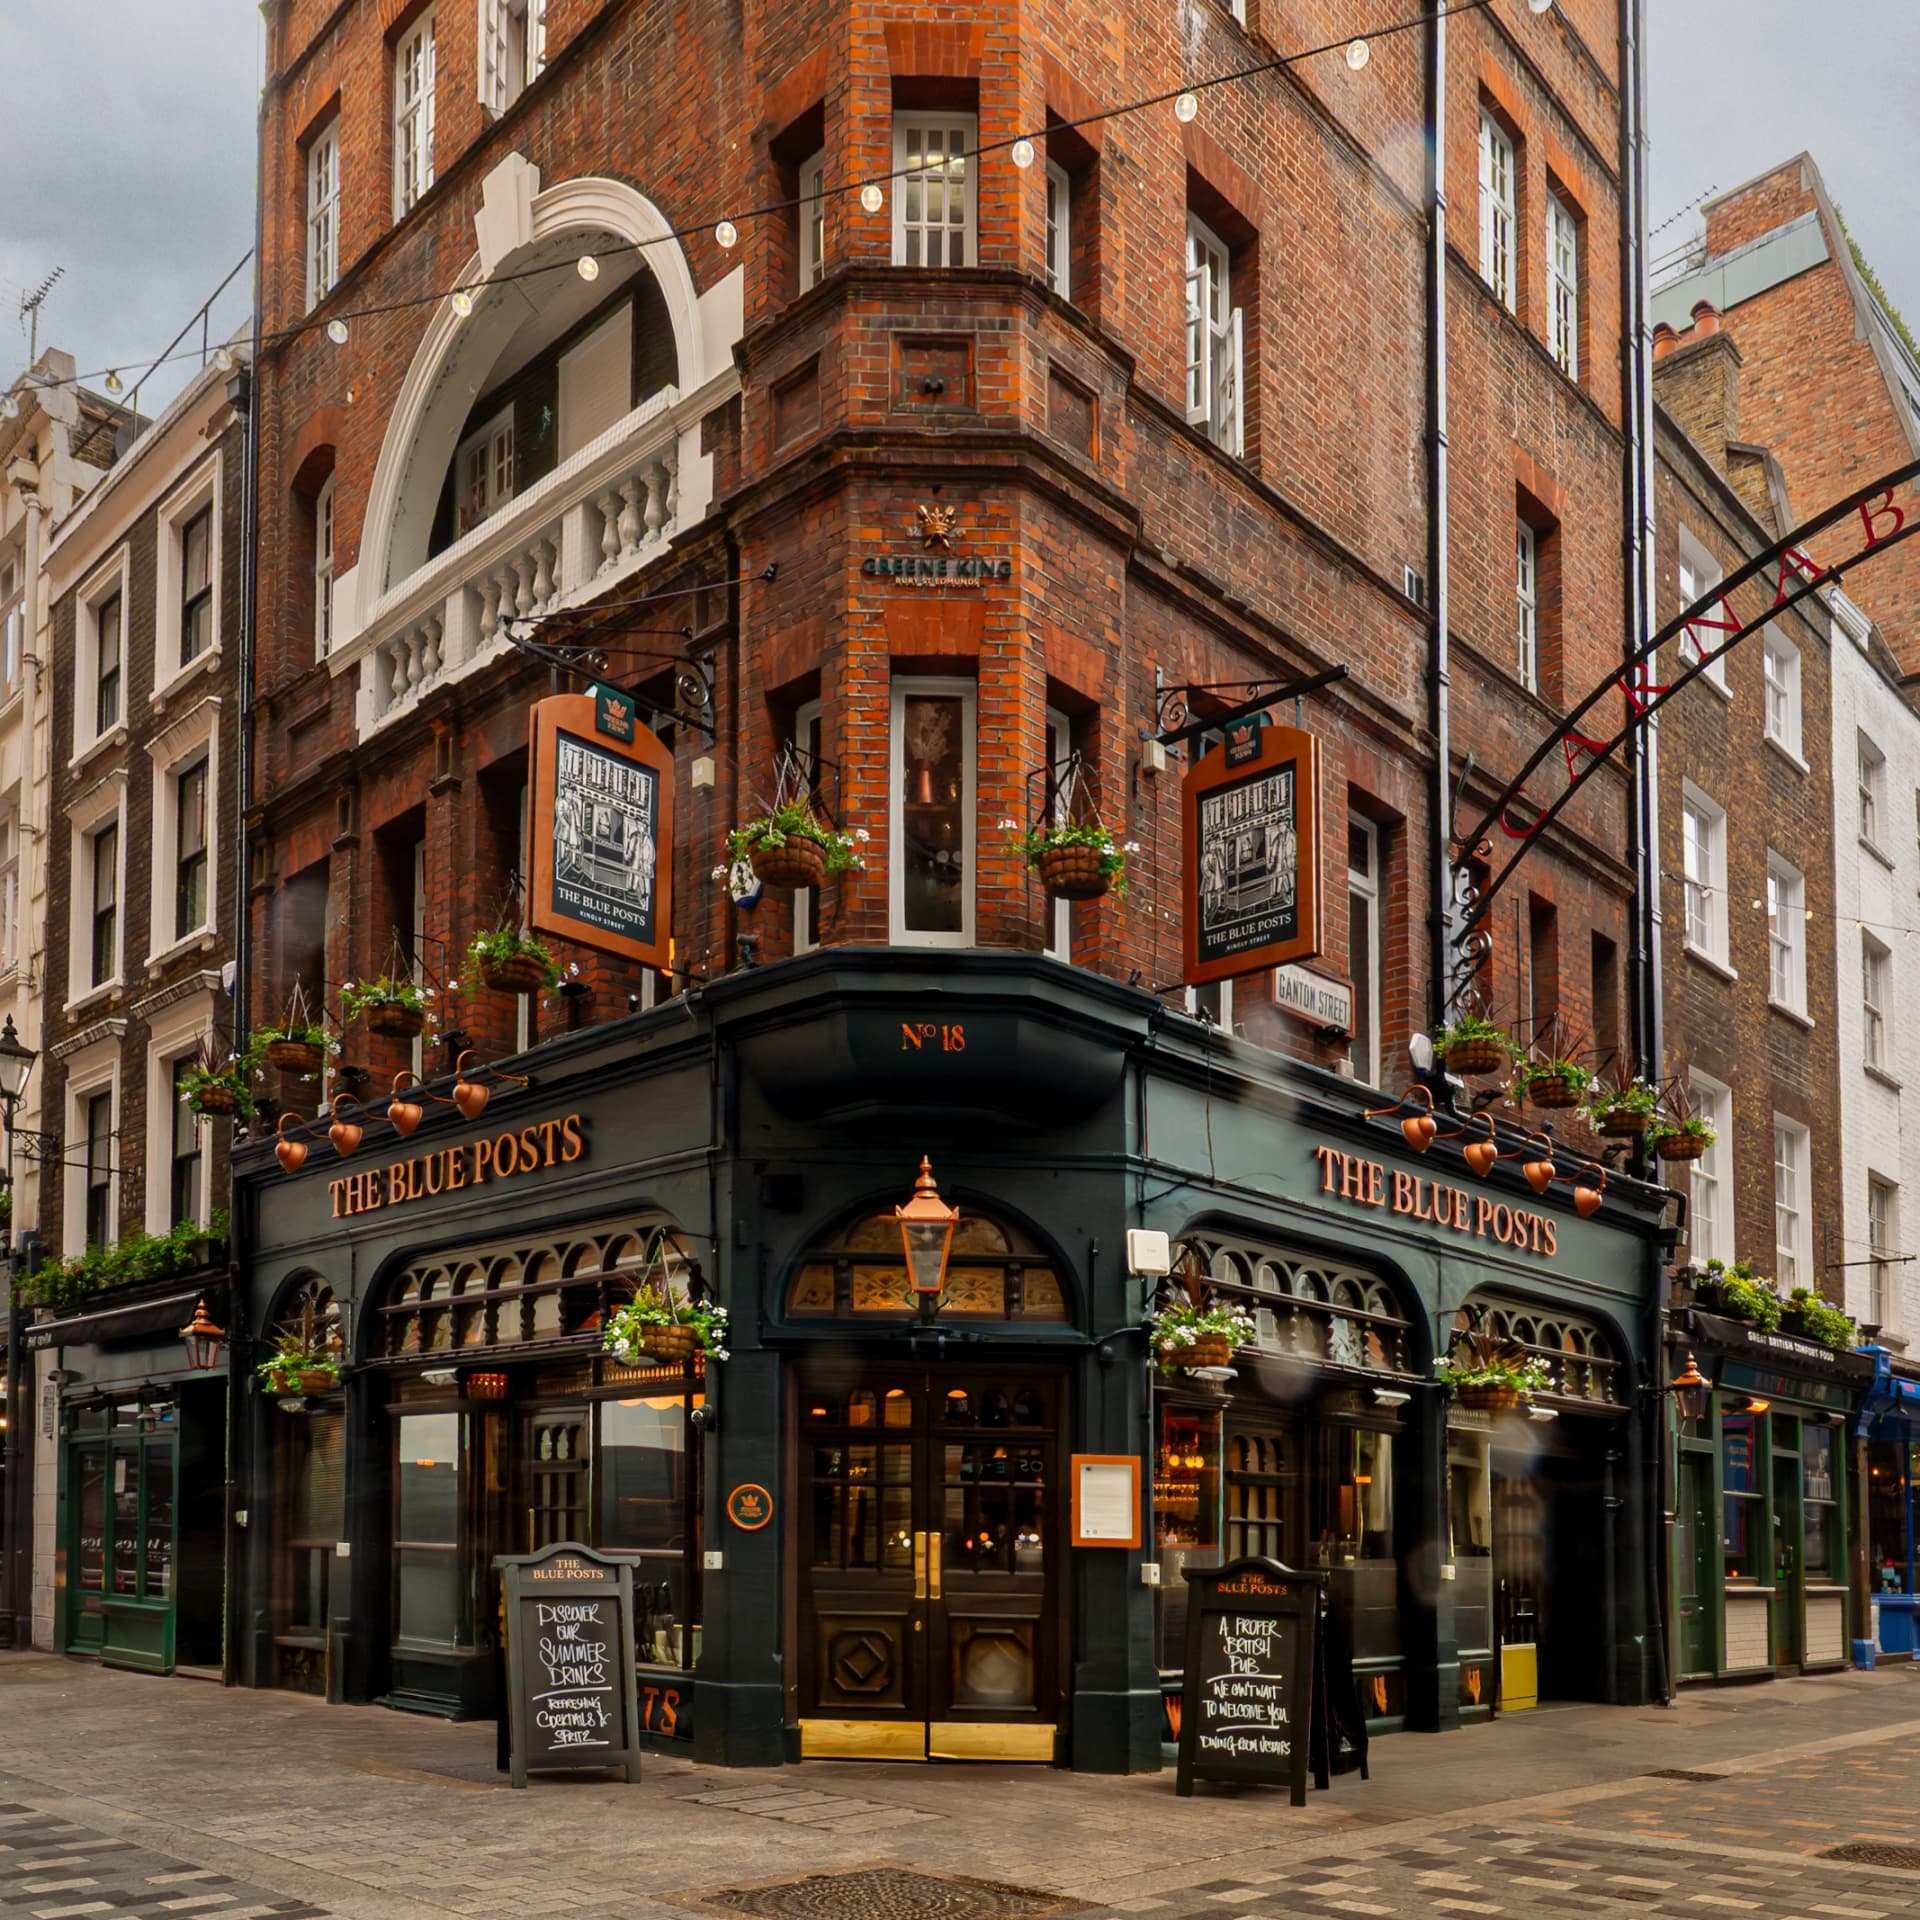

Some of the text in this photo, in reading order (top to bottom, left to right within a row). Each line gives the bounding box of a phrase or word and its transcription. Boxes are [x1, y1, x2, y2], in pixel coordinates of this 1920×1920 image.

[863, 558, 1012, 577] GREENE KING
[895, 576, 917, 585] BURY
[935, 577, 980, 586] EDMUNDS
[558, 886, 646, 926] THE BLUE POSTS
[603, 918, 625, 931] STREET
[1206, 912, 1292, 946] THE BLUE POSTS
[1279, 973, 1348, 1024] GANTON STREET
[942, 1024, 966, 1051] 18
[328, 1113, 584, 1218] THE BLUE POSTS
[1317, 1144, 1558, 1257] THE BLUE POSTS
[1747, 1330, 1767, 1344] GREAT
[1768, 1336, 1794, 1351] BRITISH
[1819, 1350, 1835, 1362] FOOD
[533, 1569, 604, 1579] BLUE POSTS
[555, 1559, 581, 1569] THE
[1241, 1574, 1265, 1584] THE
[1250, 1583, 1288, 1596] POSTS
[536, 1603, 605, 1627] DISCOVER
[556, 1623, 590, 1642] OUR
[1219, 1615, 1282, 1638] A PROPER
[539, 1637, 611, 1667] SUMMER
[1223, 1636, 1271, 1659] BRITISH
[547, 1663, 606, 1686] DRINKS
[1229, 1655, 1260, 1674] PUB
[1213, 1680, 1229, 1699] WE
[1256, 1684, 1283, 1700] WAIT
[547, 1696, 602, 1712] REFRESHING
[1202, 1700, 1217, 1718] TO
[1219, 1701, 1268, 1720] WELCOME
[536, 1710, 596, 1728] COCKTAILS
[553, 1729, 597, 1744] SPRITZ
